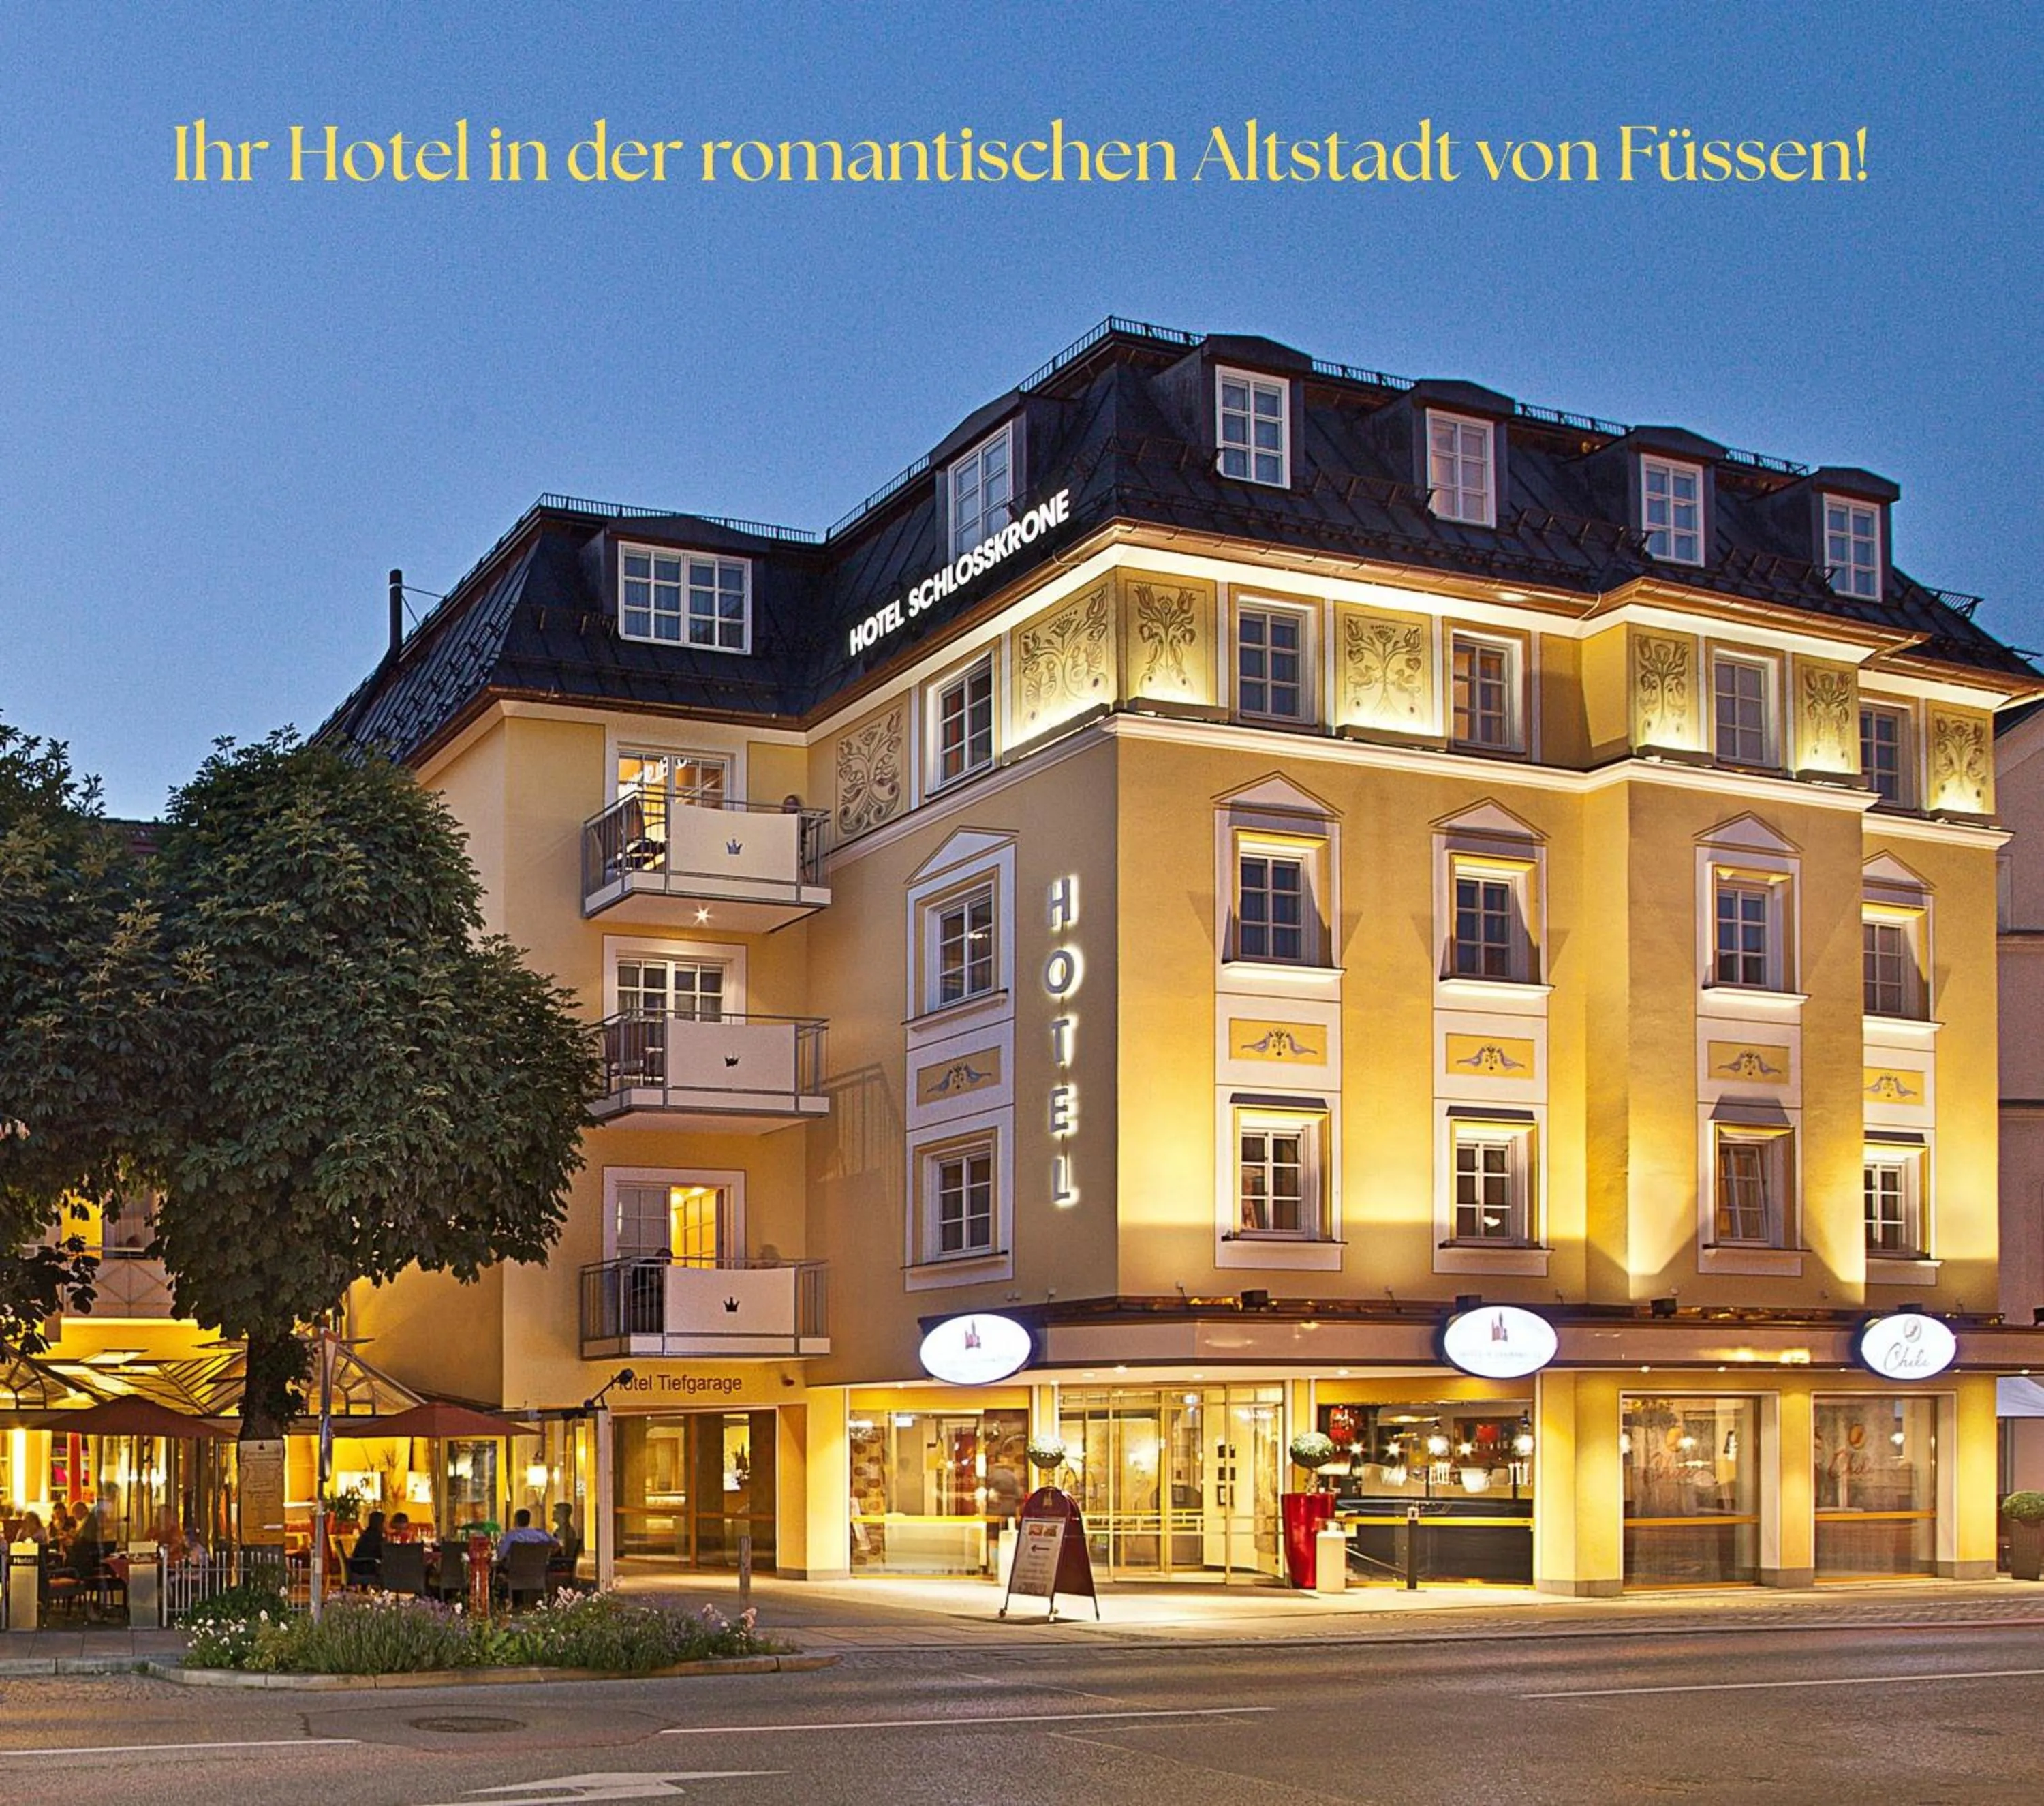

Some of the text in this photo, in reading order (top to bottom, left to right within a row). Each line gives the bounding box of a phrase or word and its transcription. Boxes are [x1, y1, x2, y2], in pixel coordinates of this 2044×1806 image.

[849, 488, 1070, 656] HOTEL SCHLOSSKRONE
[1044, 875, 1083, 1206] HOTEL
[656, 1374, 743, 1395] Tiefgarage
